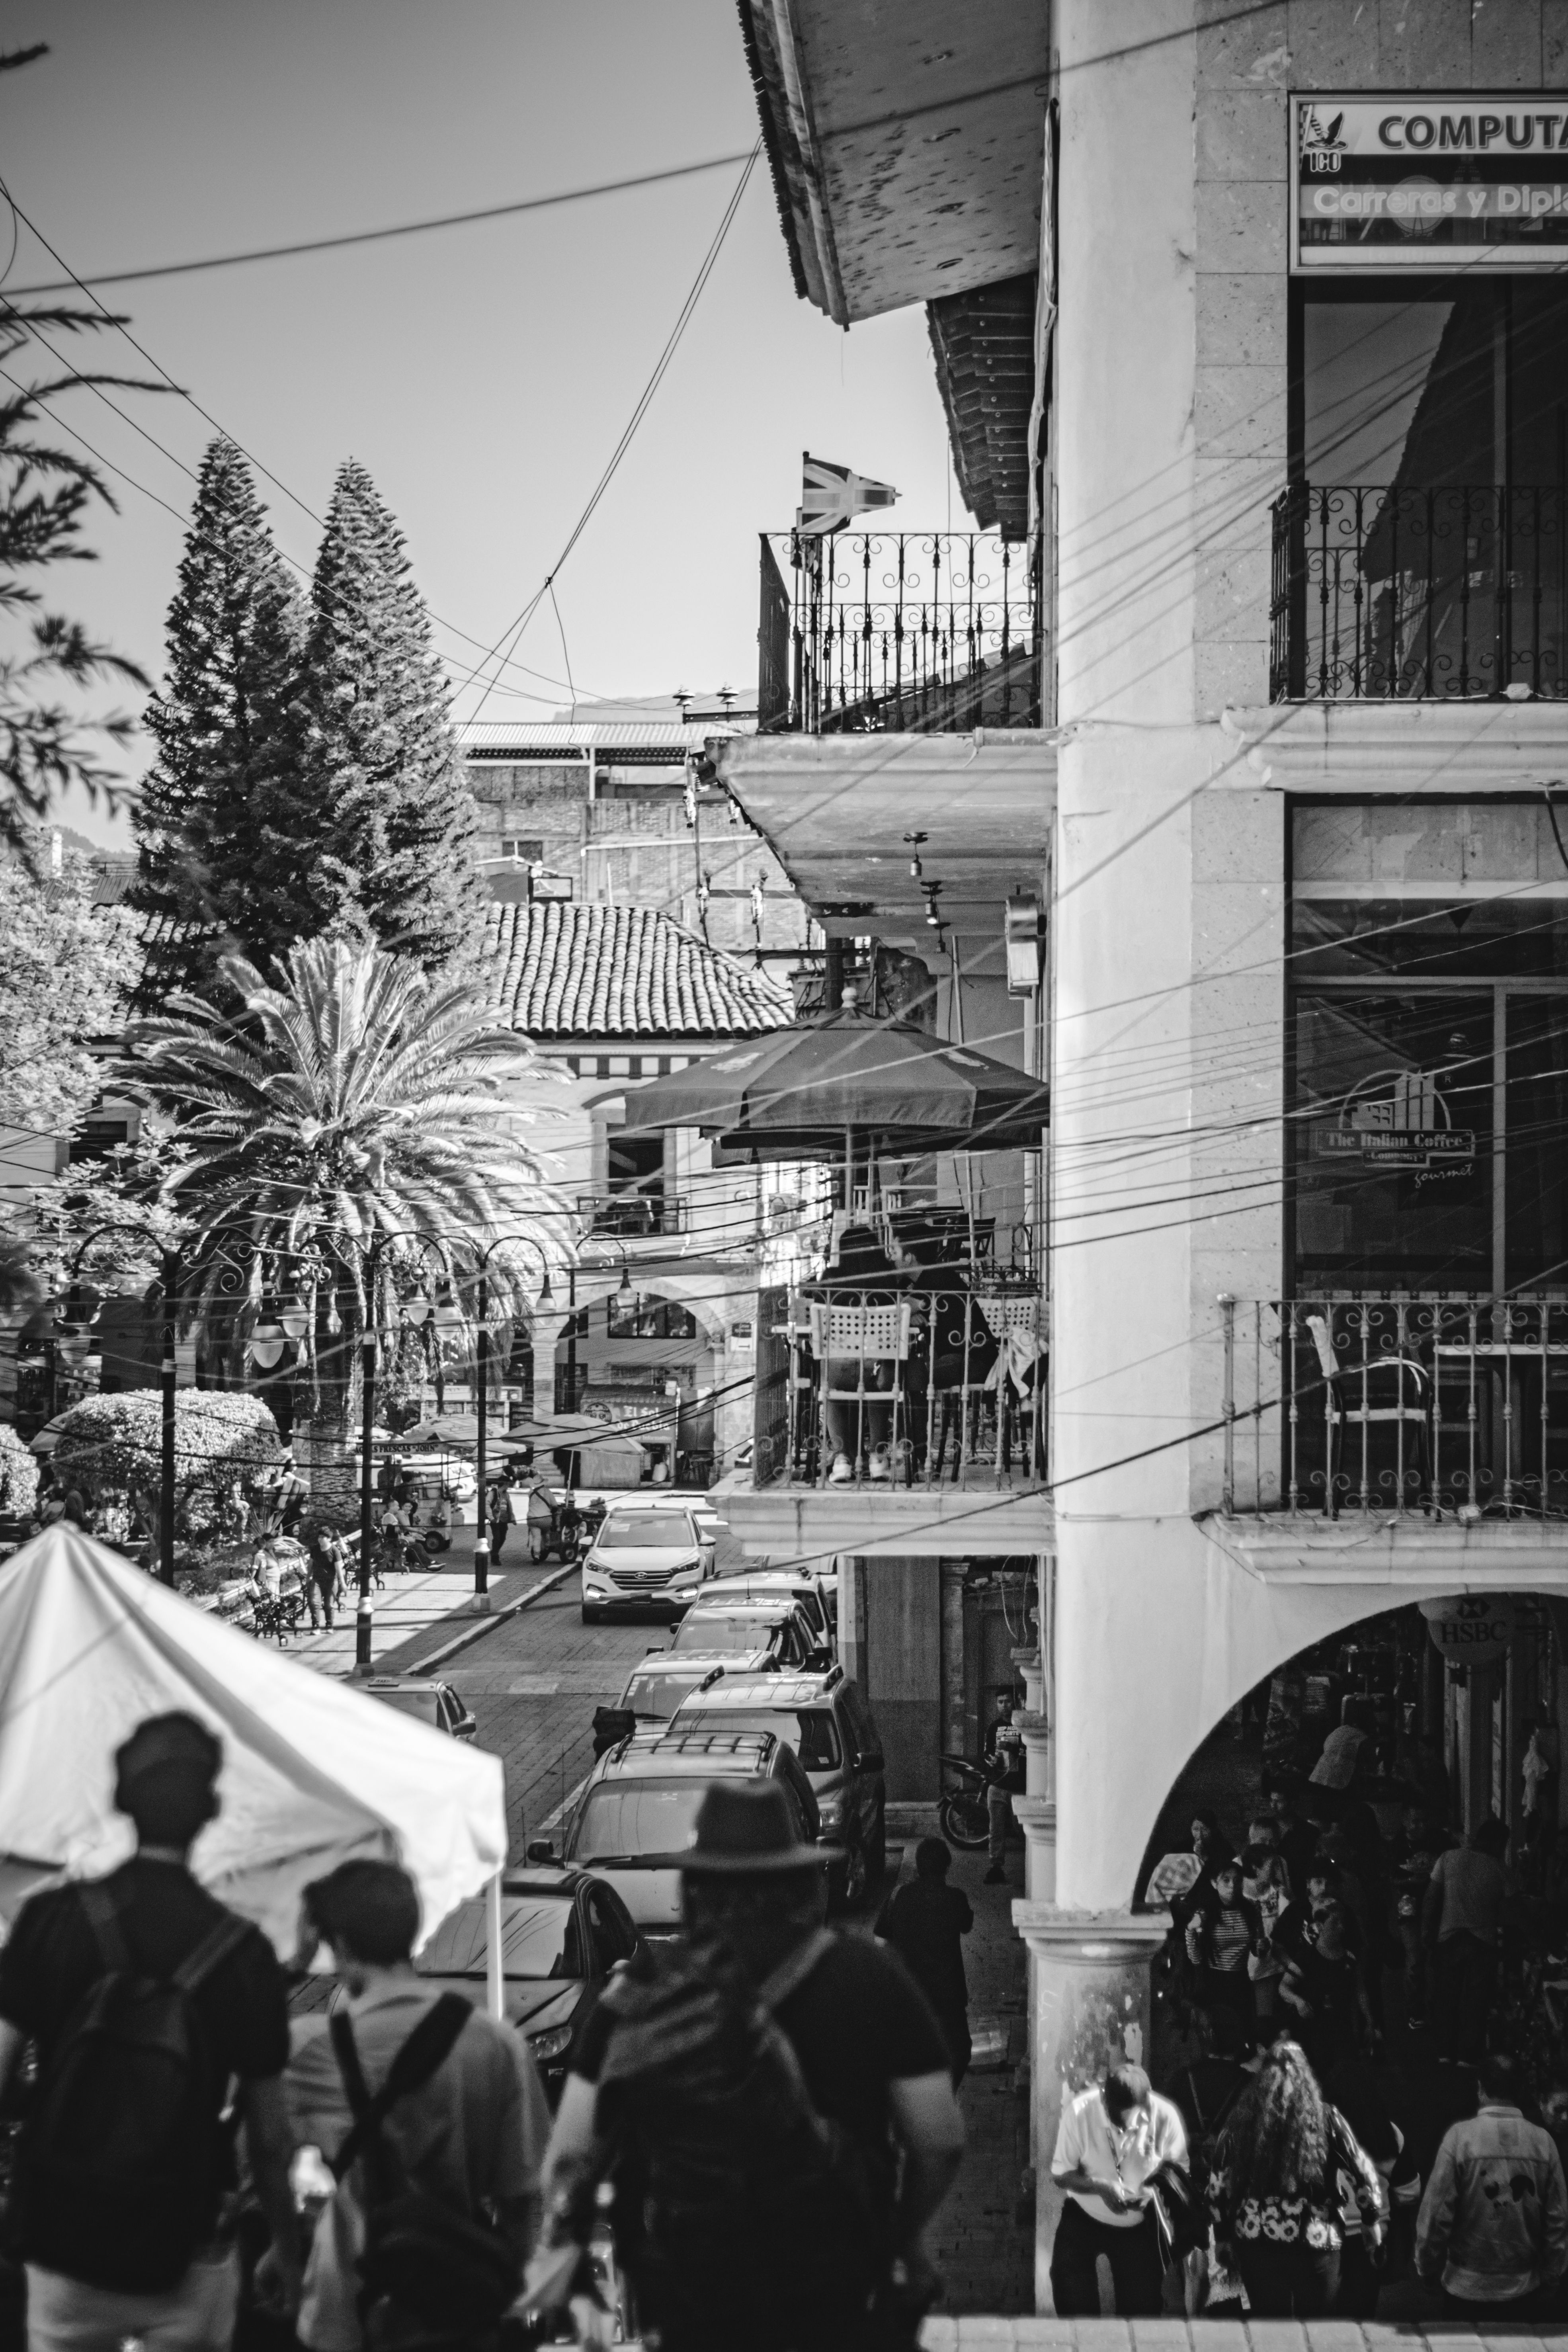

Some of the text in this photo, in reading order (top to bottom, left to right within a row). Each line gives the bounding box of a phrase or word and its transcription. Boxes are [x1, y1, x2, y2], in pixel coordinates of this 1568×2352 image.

[1310, 150, 1341, 172] ICO
[1314, 185, 1568, 217] Carreras y Dipl
[1326, 1132, 1463, 1147] The Italian Coffee
[1414, 1163, 1474, 1188] gourmet
[623, 1406, 660, 1417] El Sol
[1440, 1621, 1506, 1643] HSBC
